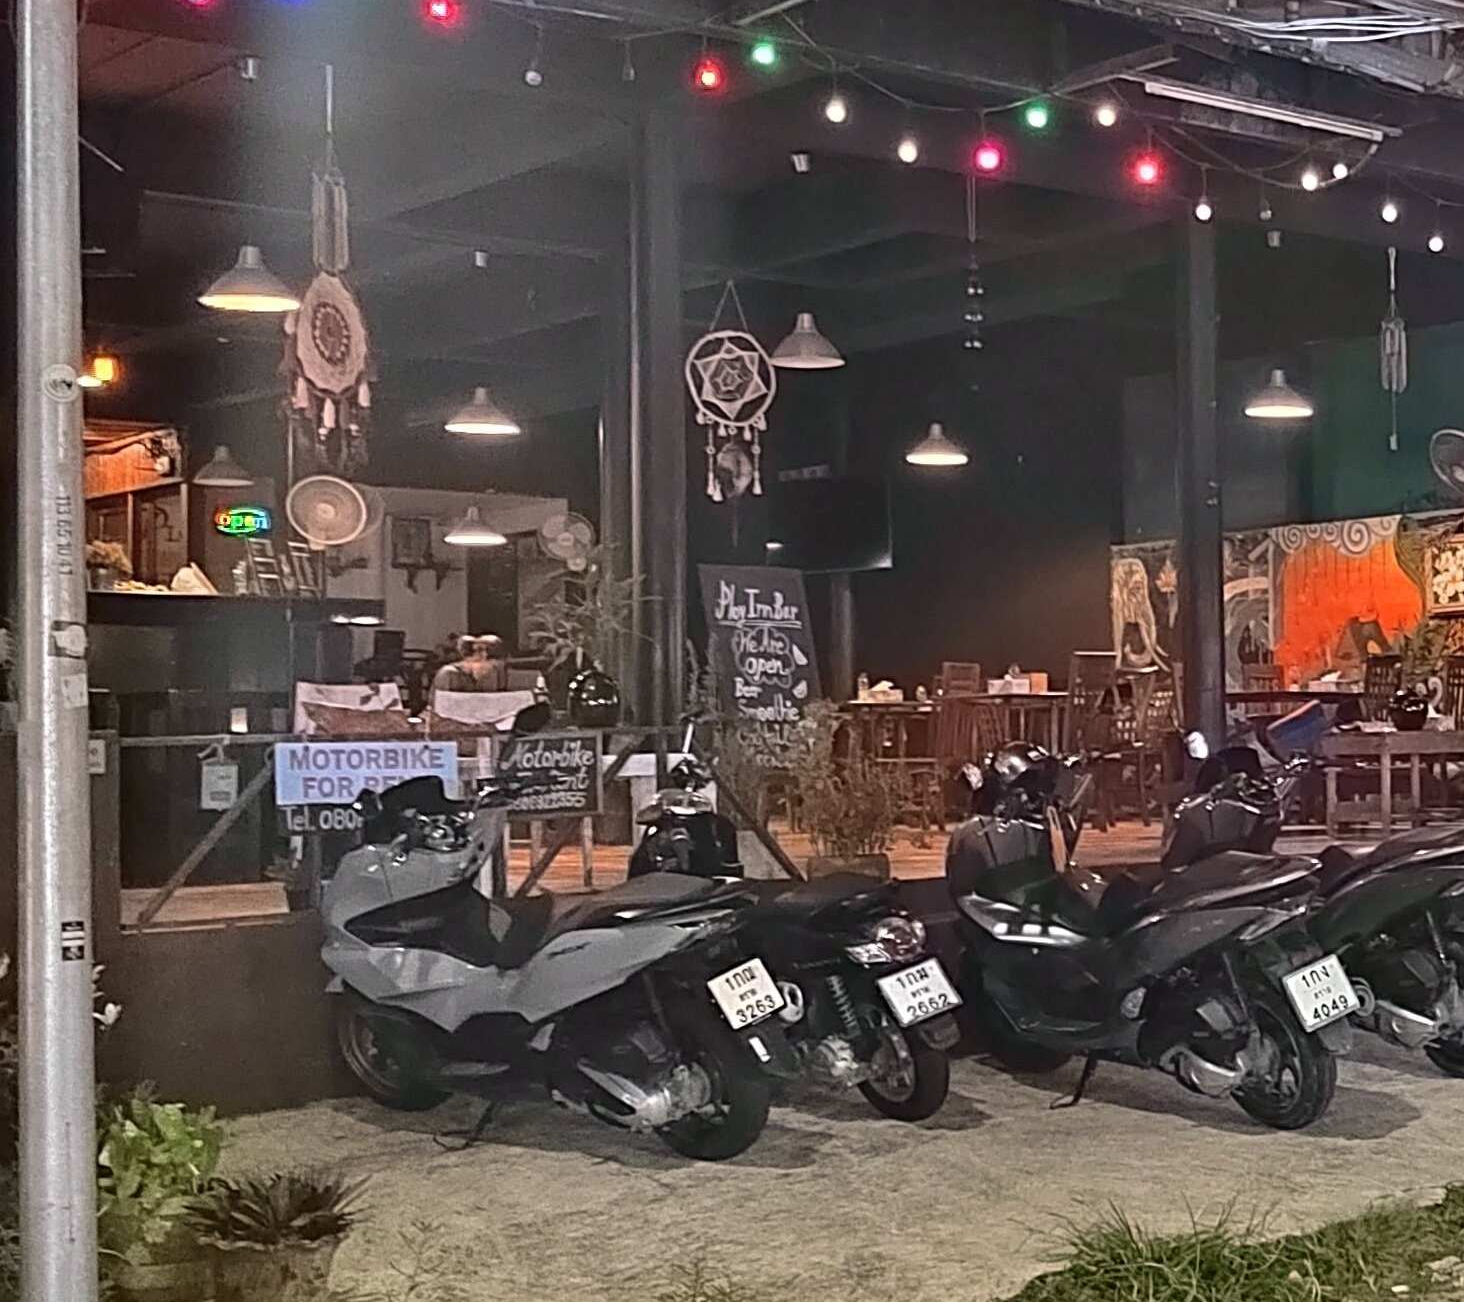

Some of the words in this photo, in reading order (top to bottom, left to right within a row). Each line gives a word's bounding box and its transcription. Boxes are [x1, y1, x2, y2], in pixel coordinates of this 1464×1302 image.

[289, 749, 445, 771] MOTORBIKE
[302, 776, 354, 799] FOR
[736, 995, 777, 1024] 3263
[907, 993, 952, 1019] 2662
[1312, 994, 1349, 1022] 4049
